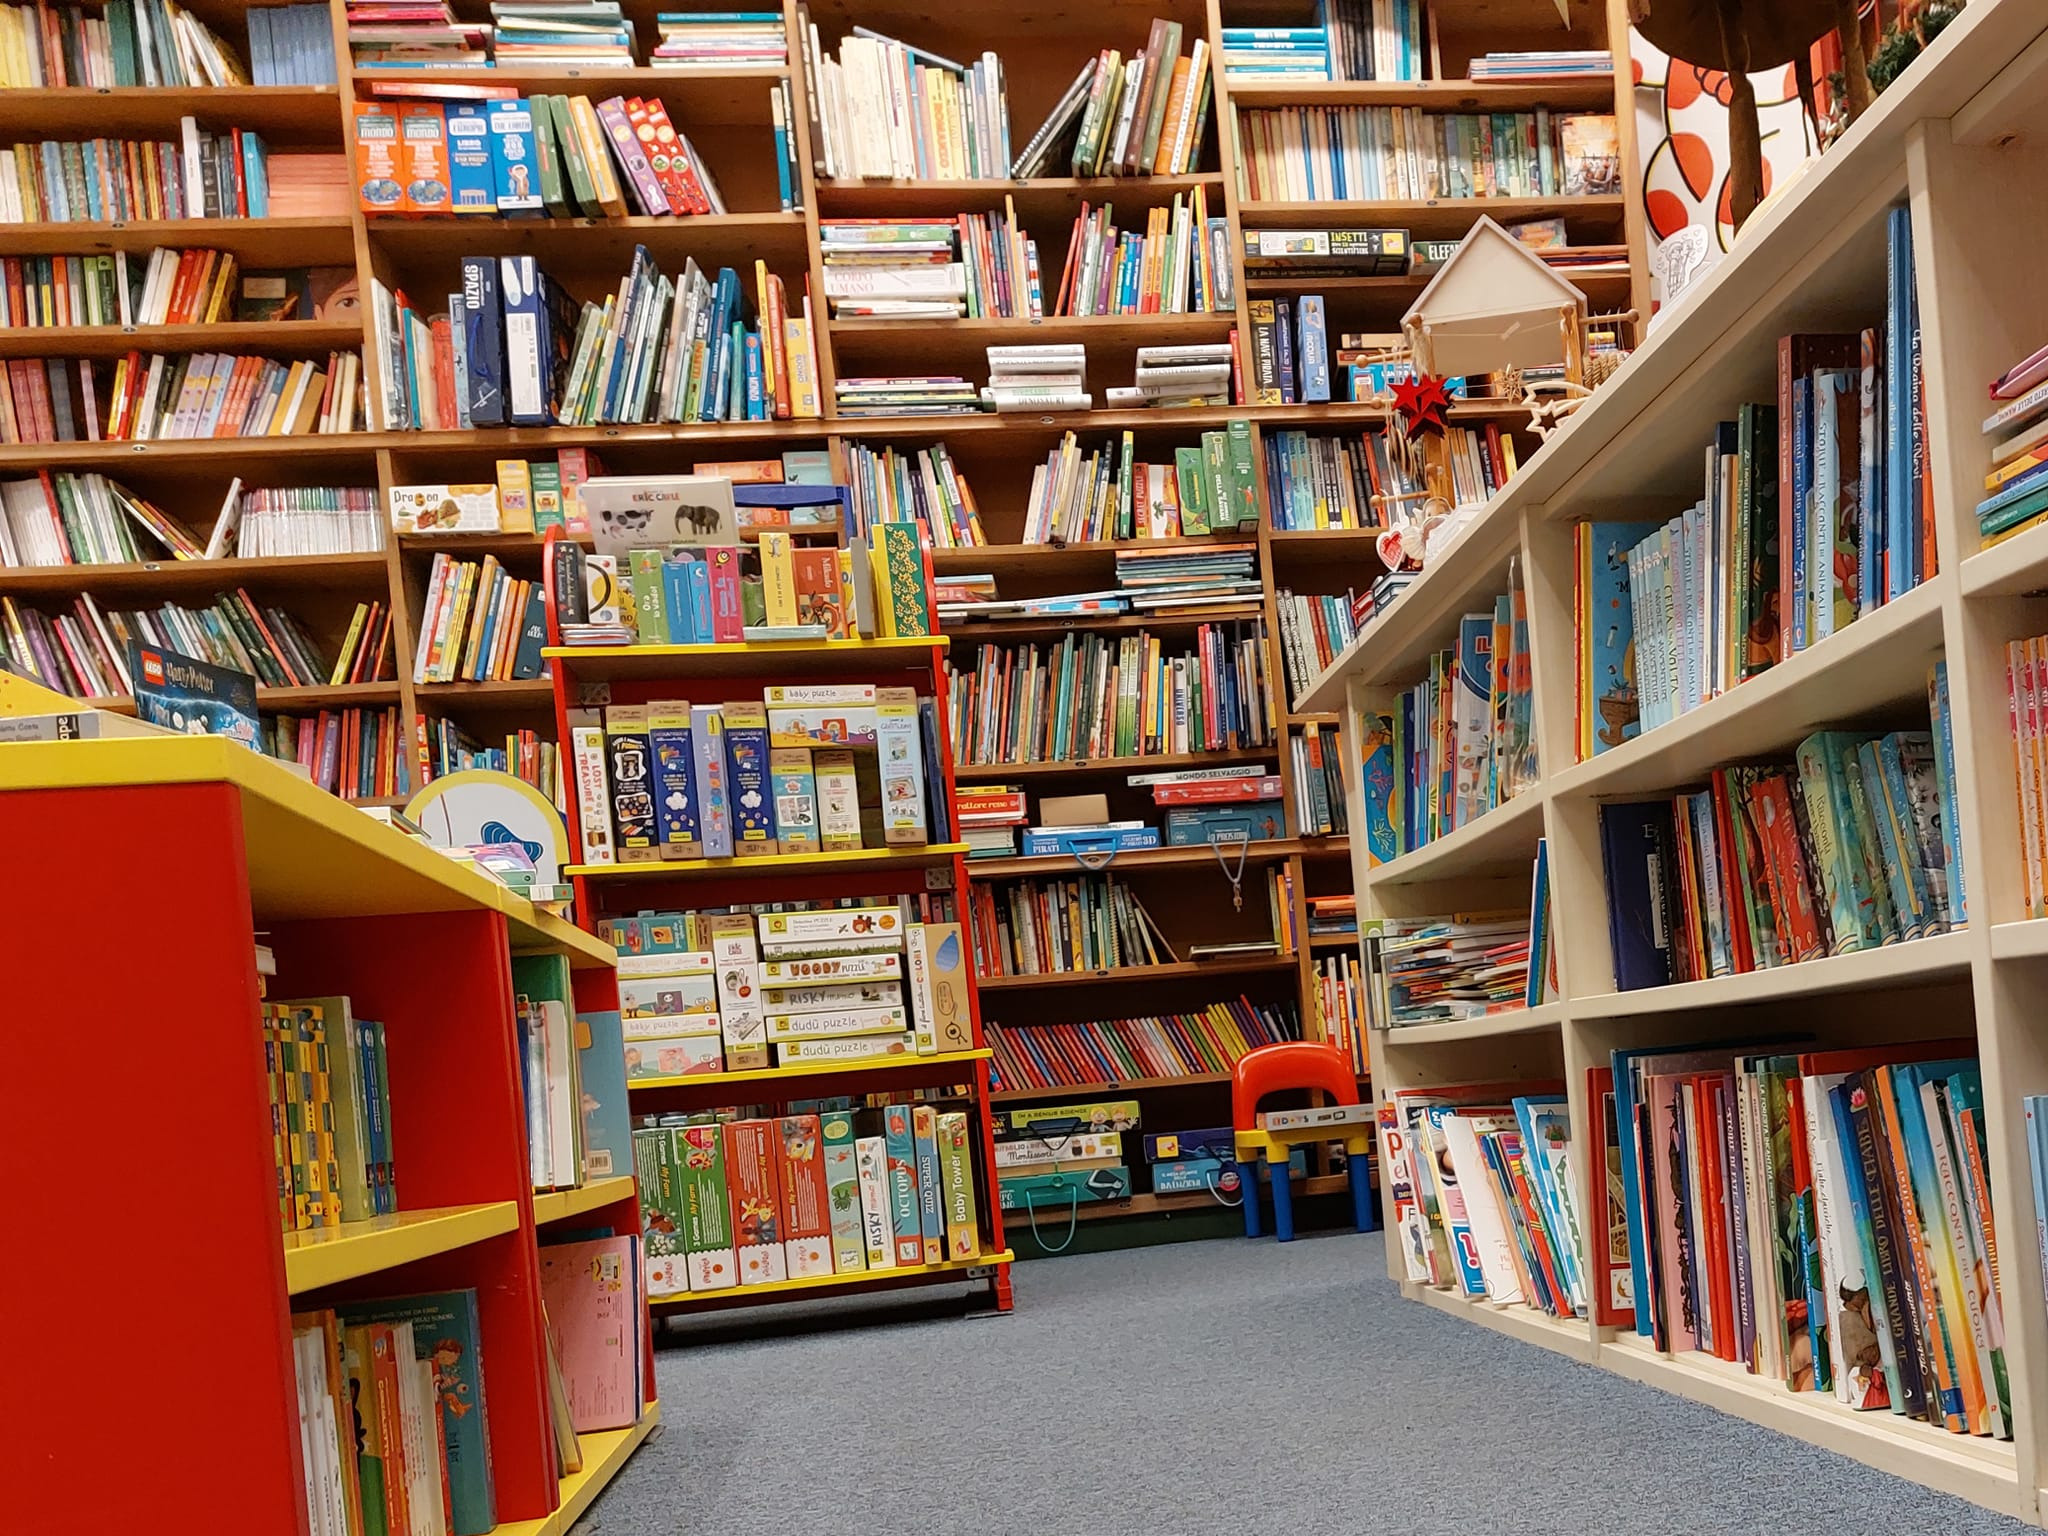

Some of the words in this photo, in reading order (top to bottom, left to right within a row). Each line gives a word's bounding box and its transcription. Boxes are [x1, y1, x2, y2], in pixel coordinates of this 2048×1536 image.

[1330, 231, 1368, 242] INSETTI
[464, 264, 481, 310] SPAZIO
[831, 282, 875, 294] UMANO
[834, 271, 874, 282] CORPO
[1258, 326, 1268, 336] LA
[692, 341, 706, 380] INSETTI
[1259, 338, 1271, 358] NAVE
[1261, 358, 1273, 384] PIRATA
[1794, 411, 1804, 458] Racconti
[1794, 462, 1803, 482] per
[632, 493, 655, 502] ERIC
[1135, 476, 1145, 499] PUZZLE
[821, 556, 833, 589] Mikado
[641, 595, 652, 611] Ora
[1818, 561, 1828, 618] ANIMALI
[145, 661, 162, 675] LEGO
[1288, 651, 1300, 680] RECORDS
[1294, 651, 1307, 680] RECORDS
[1668, 647, 1680, 694] VOLTA
[189, 667, 214, 694] Potter
[789, 688, 810, 699] baby
[811, 687, 837, 699] puzzle
[1688, 658, 1698, 704] ANIMALI
[1176, 688, 1186, 726] UNIVERSO
[578, 752, 594, 803] TREASURE
[591, 764, 602, 789] LOST
[1175, 772, 1207, 781] MONDO
[1207, 768, 1251, 779] SELVAGGIO
[986, 801, 1008, 809] rosso
[1699, 811, 1711, 859] Classici
[1815, 794, 1833, 856] Racconti
[1032, 844, 1060, 854] PIRATI
[1142, 835, 1157, 846] 3D
[1703, 862, 1717, 912] illustrati
[841, 962, 866, 973] PUZZLE
[789, 990, 826, 1006] RISKY
[823, 1016, 857, 1028] puzzle
[834, 1042, 869, 1054] puzzle
[1760, 1096, 1770, 1134] FORESTA
[1963, 1101, 1974, 1134] FAVOLE
[659, 1141, 667, 1166] Games
[1007, 1149, 1055, 1161] Montessori
[1764, 1136, 1774, 1180] INCANTATA
[1857, 1116, 1878, 1182] FIABE
[660, 1166, 669, 1178] My
[921, 1157, 933, 1189] SUPER
[953, 1155, 965, 1189] Tower
[661, 1178, 670, 1199] Farm
[688, 1184, 696, 1200] Farm
[895, 1158, 912, 1218] OCTOPUS
[1897, 1169, 1914, 1216] delfini
[690, 1200, 699, 1214] My
[924, 1189, 936, 1215] QUIZ
[953, 1192, 968, 1222] Baby
[1868, 1185, 1887, 1230] DELLE
[691, 1216, 700, 1239] Games
[867, 1212, 885, 1248] RISKY
[1726, 1108, 1736, 1153] STORIE
[1737, 1255, 1749, 1328] INCANTESIMI
[1940, 1153, 1967, 1251] RACCONTI
[1960, 1257, 1971, 1282] DEL
[1908, 1222, 1920, 1244] dei
[1877, 1235, 1892, 1276] LIBRO
[1886, 1280, 1905, 1339] GRANDE
[1900, 1278, 1919, 1336] incantate
[1894, 1344, 1909, 1363] IL
[1914, 1337, 1930, 1377] Fiabe
[1813, 1355, 1821, 1382] DAMI
